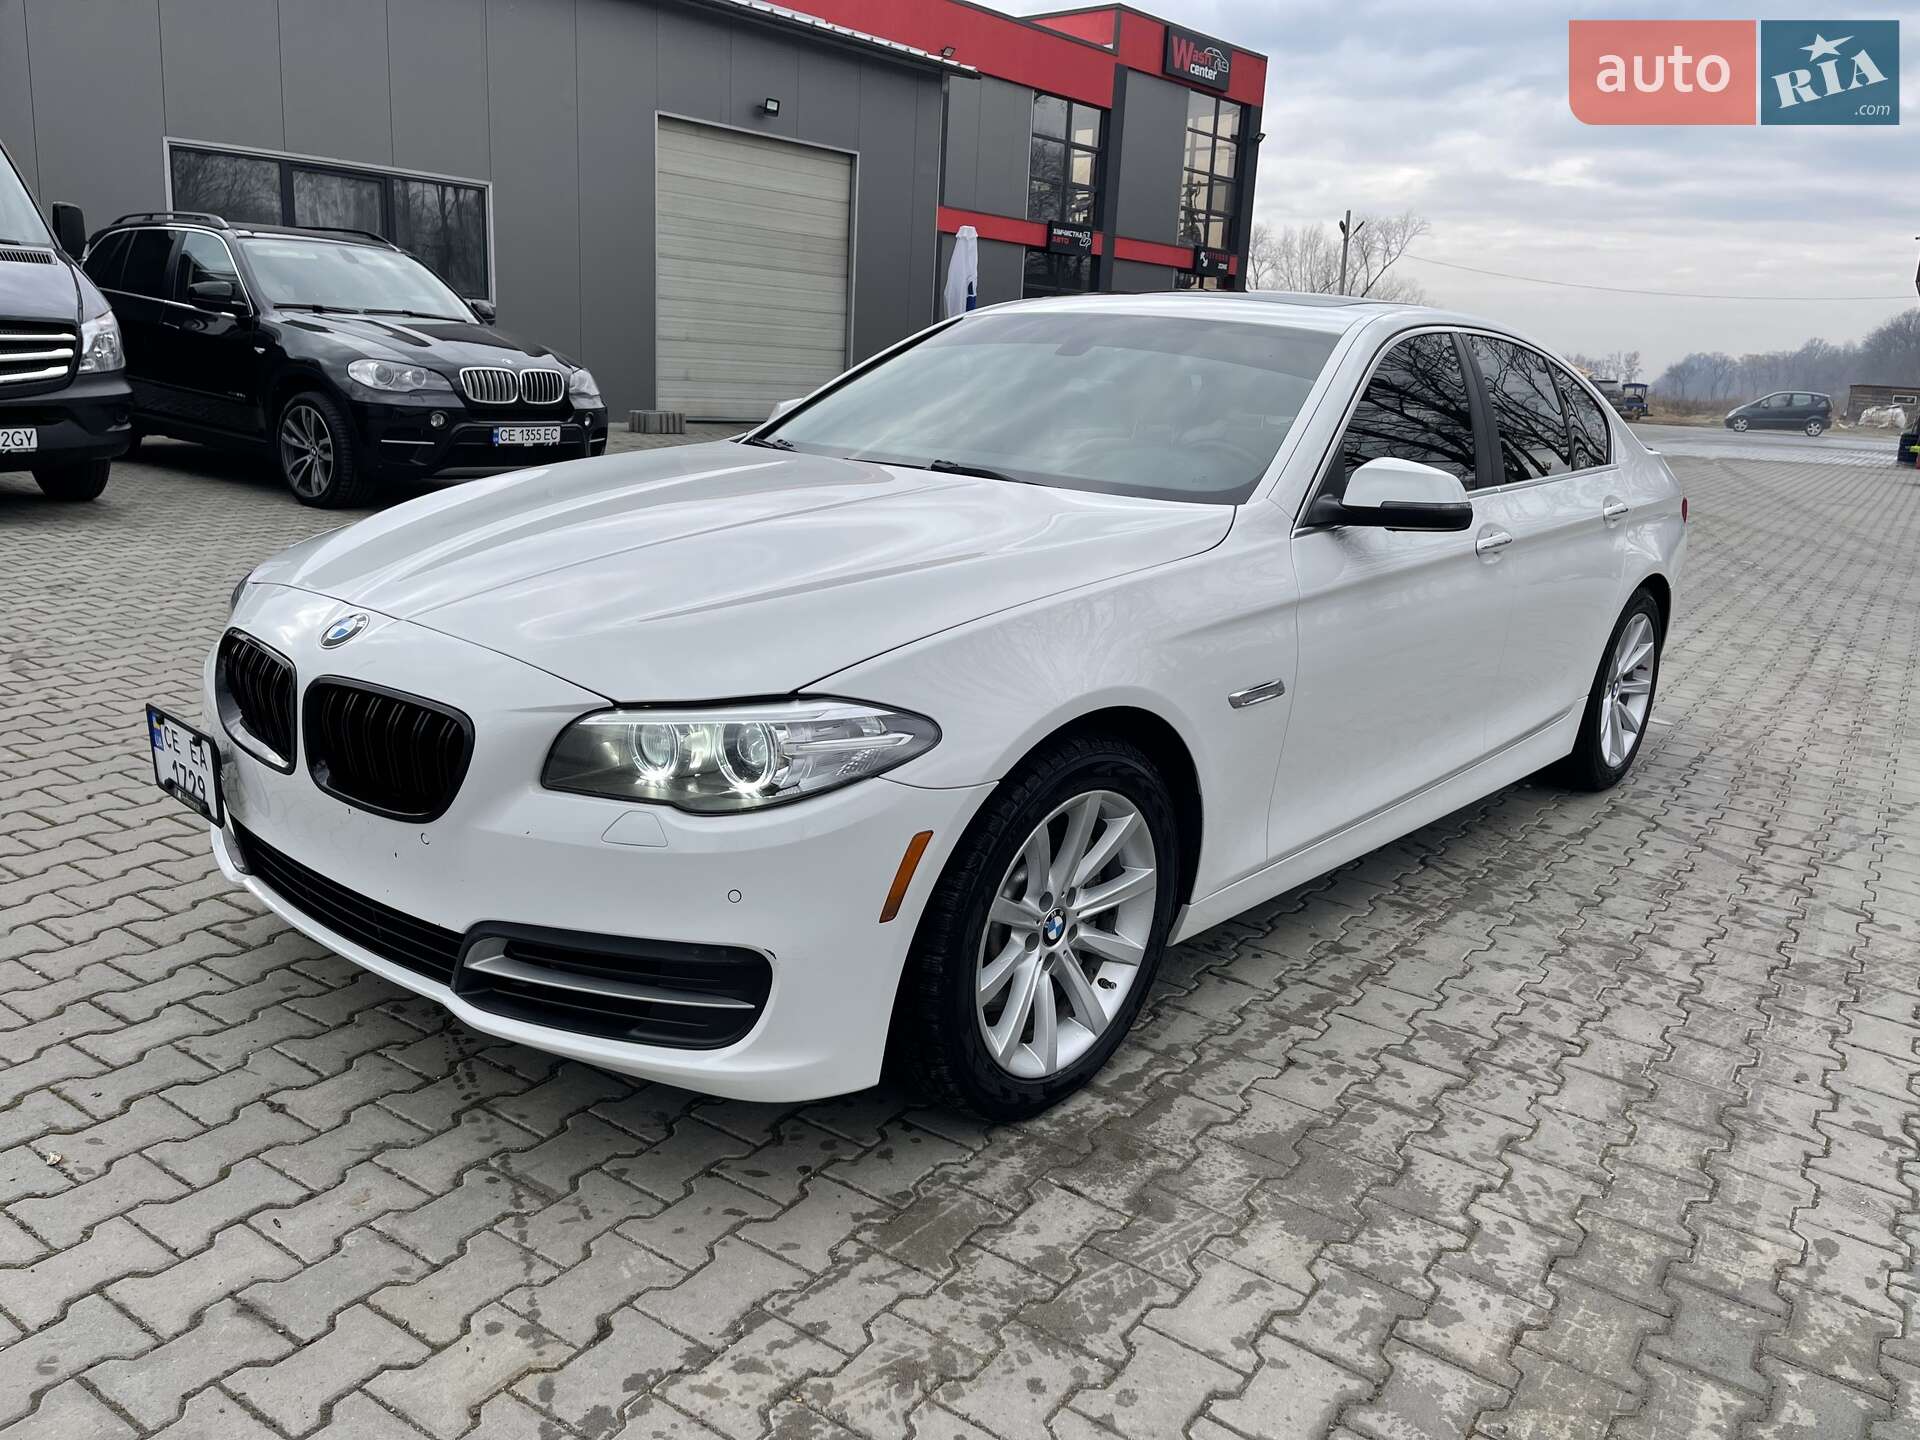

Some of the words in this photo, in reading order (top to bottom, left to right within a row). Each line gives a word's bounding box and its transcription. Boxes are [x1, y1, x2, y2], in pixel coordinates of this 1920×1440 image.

[1172, 33, 1212, 72] Wash
[1189, 63, 1217, 80] center
[1, 431, 34, 447] 2GY
[500, 429, 516, 441] CE
[519, 429, 541, 441] 1355
[544, 428, 558, 440] EC
[164, 726, 181, 756] CE
[189, 740, 208, 772] EA
[172, 760, 206, 801] 1729
